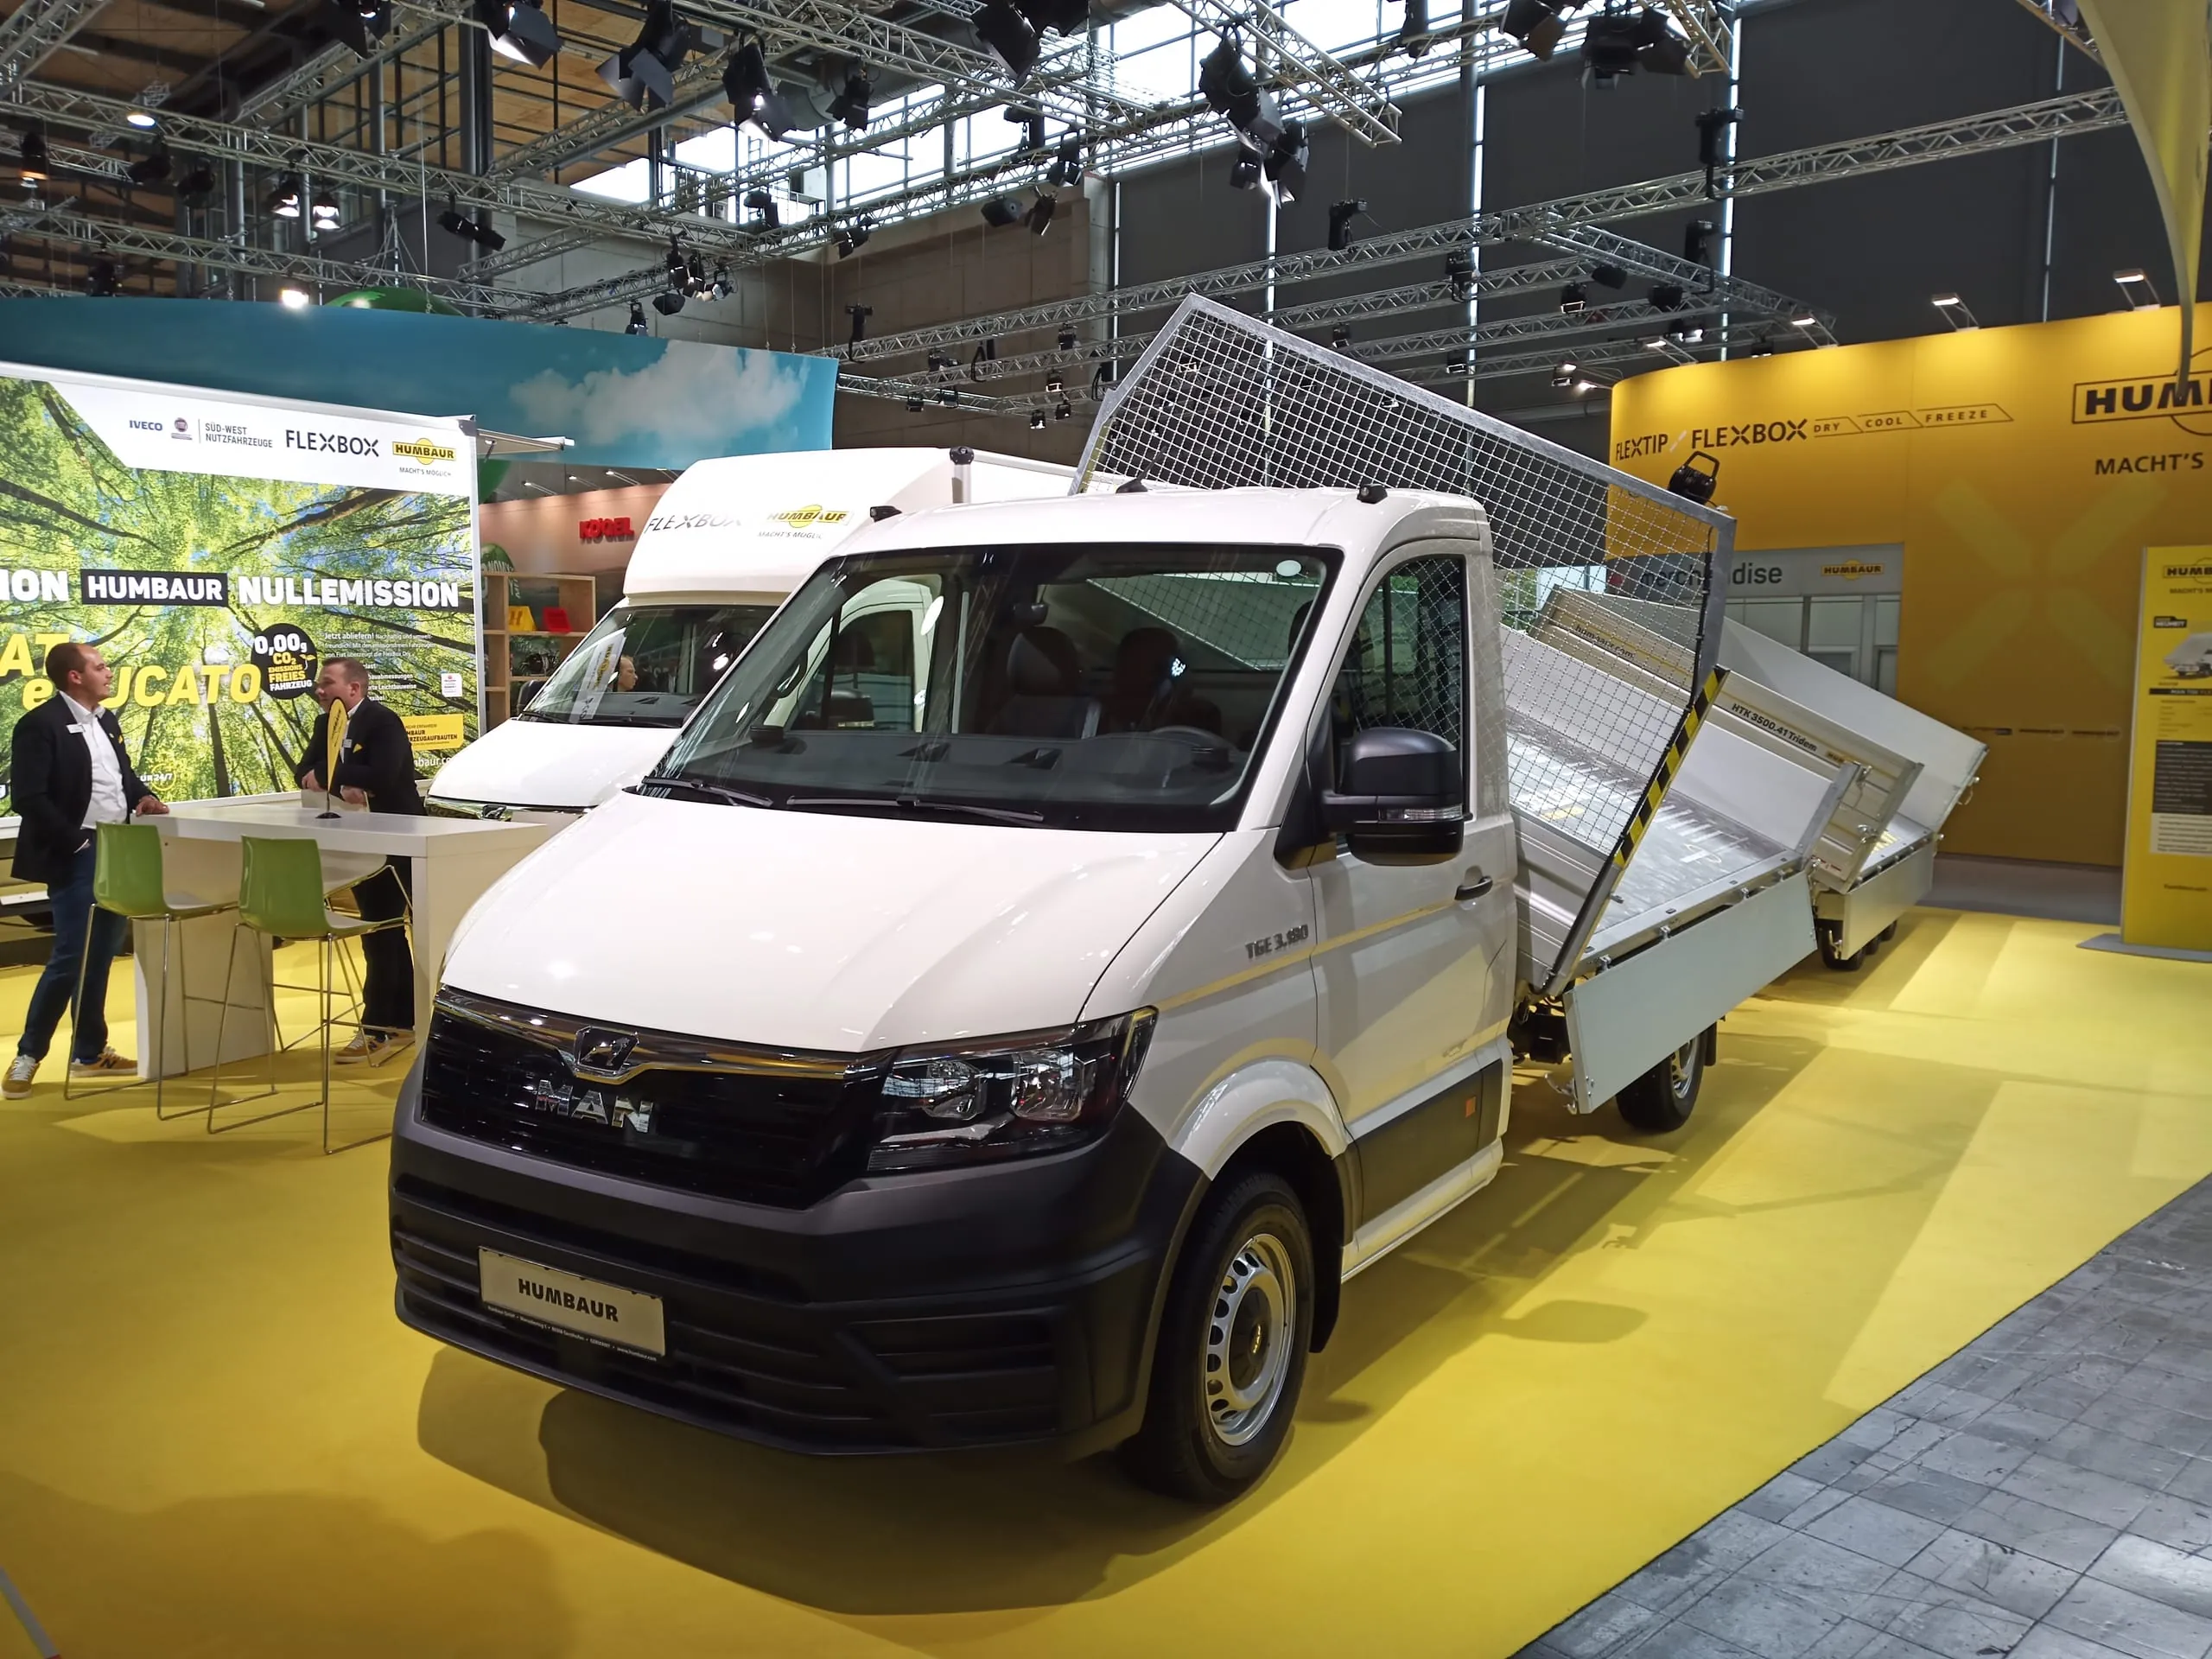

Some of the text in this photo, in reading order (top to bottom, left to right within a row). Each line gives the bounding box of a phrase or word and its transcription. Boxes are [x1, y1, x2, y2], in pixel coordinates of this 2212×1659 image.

[2086, 379, 2212, 415] HUM
[129, 420, 163, 431] IVECO
[205, 423, 248, 435] SÜD-WEST
[1692, 410, 1989, 448] FLEXBOX DRY COOL FREEZE
[205, 433, 273, 448] NUTZFAHRZEUGE
[285, 429, 379, 457] FLEXBOX
[395, 443, 454, 459] HUMBAUR
[1615, 433, 1668, 461] FLEXTIP
[2095, 452, 2204, 475] MACHT'S
[643, 514, 741, 534] FLEXBOX
[1823, 565, 1882, 575] HUMBAUR
[88, 575, 223, 601] HUMBAUR
[238, 576, 459, 607] NULLEMISSION
[268, 664, 303, 673] EMISSIONS
[269, 670, 307, 683] FREIES
[270, 679, 313, 691] FAHRZEUG
[1732, 703, 1817, 752] HTK 3500.41 Tridem
[1244, 937, 1273, 959] TGE
[535, 1079, 654, 1134] MAN
[518, 1278, 619, 1323] HUMBAUR
